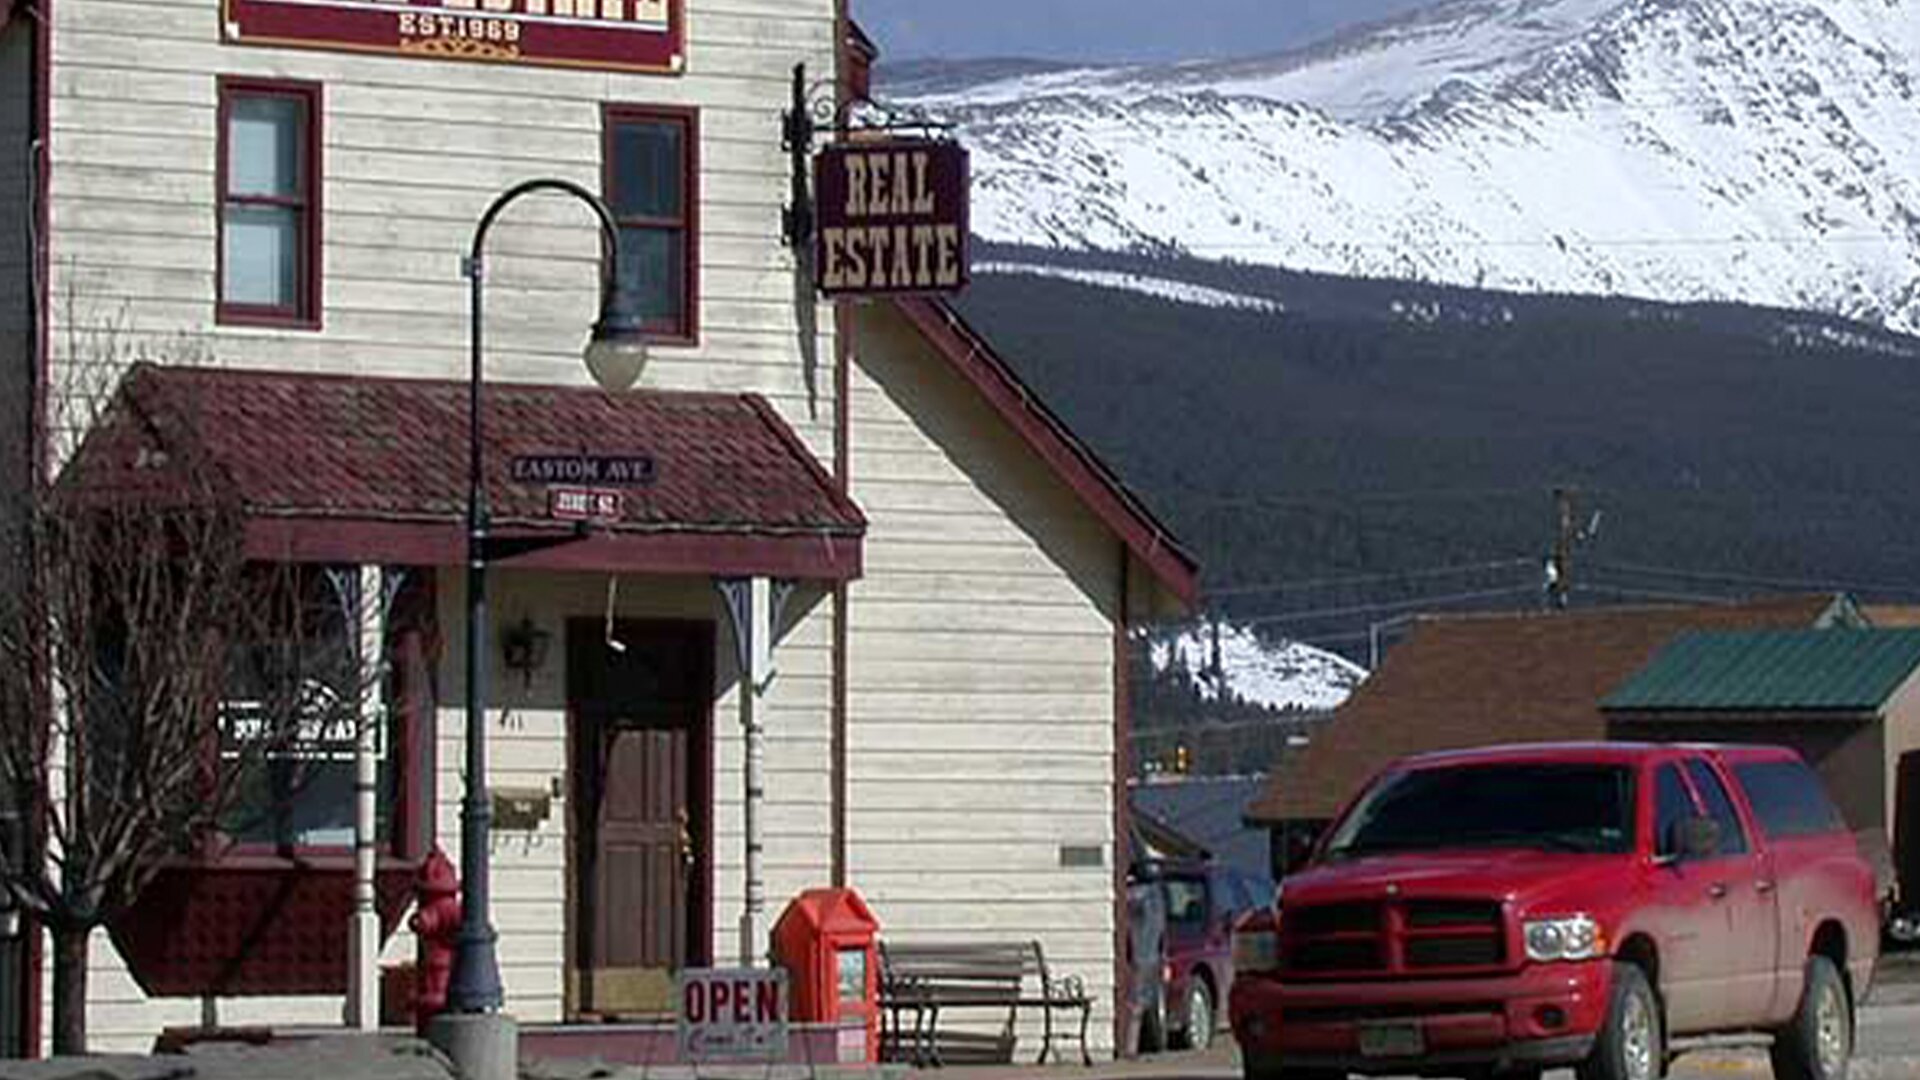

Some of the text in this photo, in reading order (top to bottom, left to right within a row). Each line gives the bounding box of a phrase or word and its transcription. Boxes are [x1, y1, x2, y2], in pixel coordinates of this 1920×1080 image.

[845, 152, 936, 216] REAL
[823, 223, 959, 289] ESTATE
[686, 980, 778, 1023] OPEN
